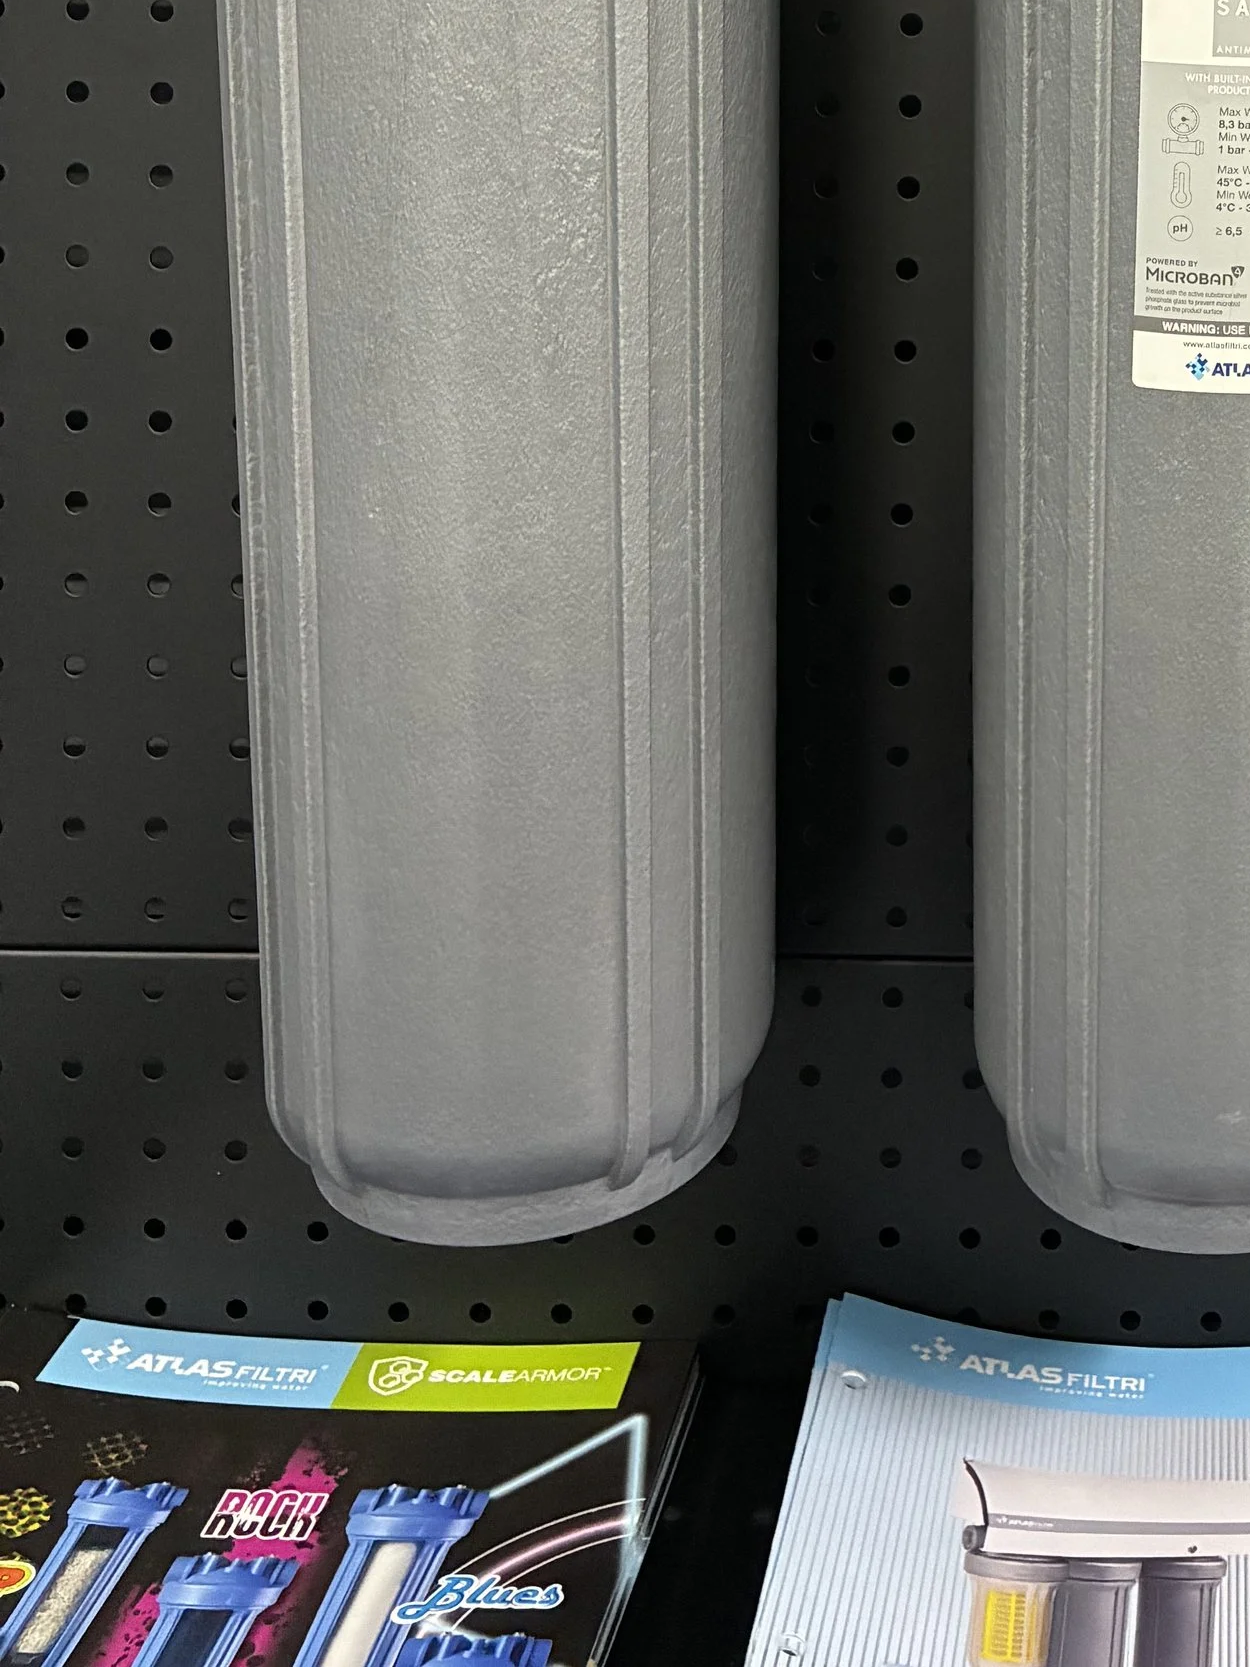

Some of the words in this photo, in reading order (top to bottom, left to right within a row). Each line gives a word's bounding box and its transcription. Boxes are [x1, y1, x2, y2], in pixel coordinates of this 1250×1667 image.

[1185, 73, 1211, 82] WITH
[1208, 85, 1250, 95] PRODUCT
[1219, 108, 1241, 117] Max
[1219, 121, 1235, 130] 8,3
[1219, 133, 1237, 142] Min
[1227, 146, 1245, 154] bar
[1217, 166, 1239, 174] Max
[1217, 191, 1235, 199] Min
[1172, 224, 1188, 234] pH
[1146, 258, 1186, 266] POWERED
[1162, 321, 1220, 334] WARNING:
[1223, 324, 1246, 335] USE
[128, 1352, 234, 1379] ATLAS
[234, 1364, 319, 1384] FILTRI
[428, 1366, 601, 1383] SCALEARMOR
[960, 1356, 1064, 1387] ATLAS
[1066, 1369, 1147, 1392] FILTRI
[200, 1488, 328, 1540] ROCK
[391, 1575, 564, 1625] Blues
